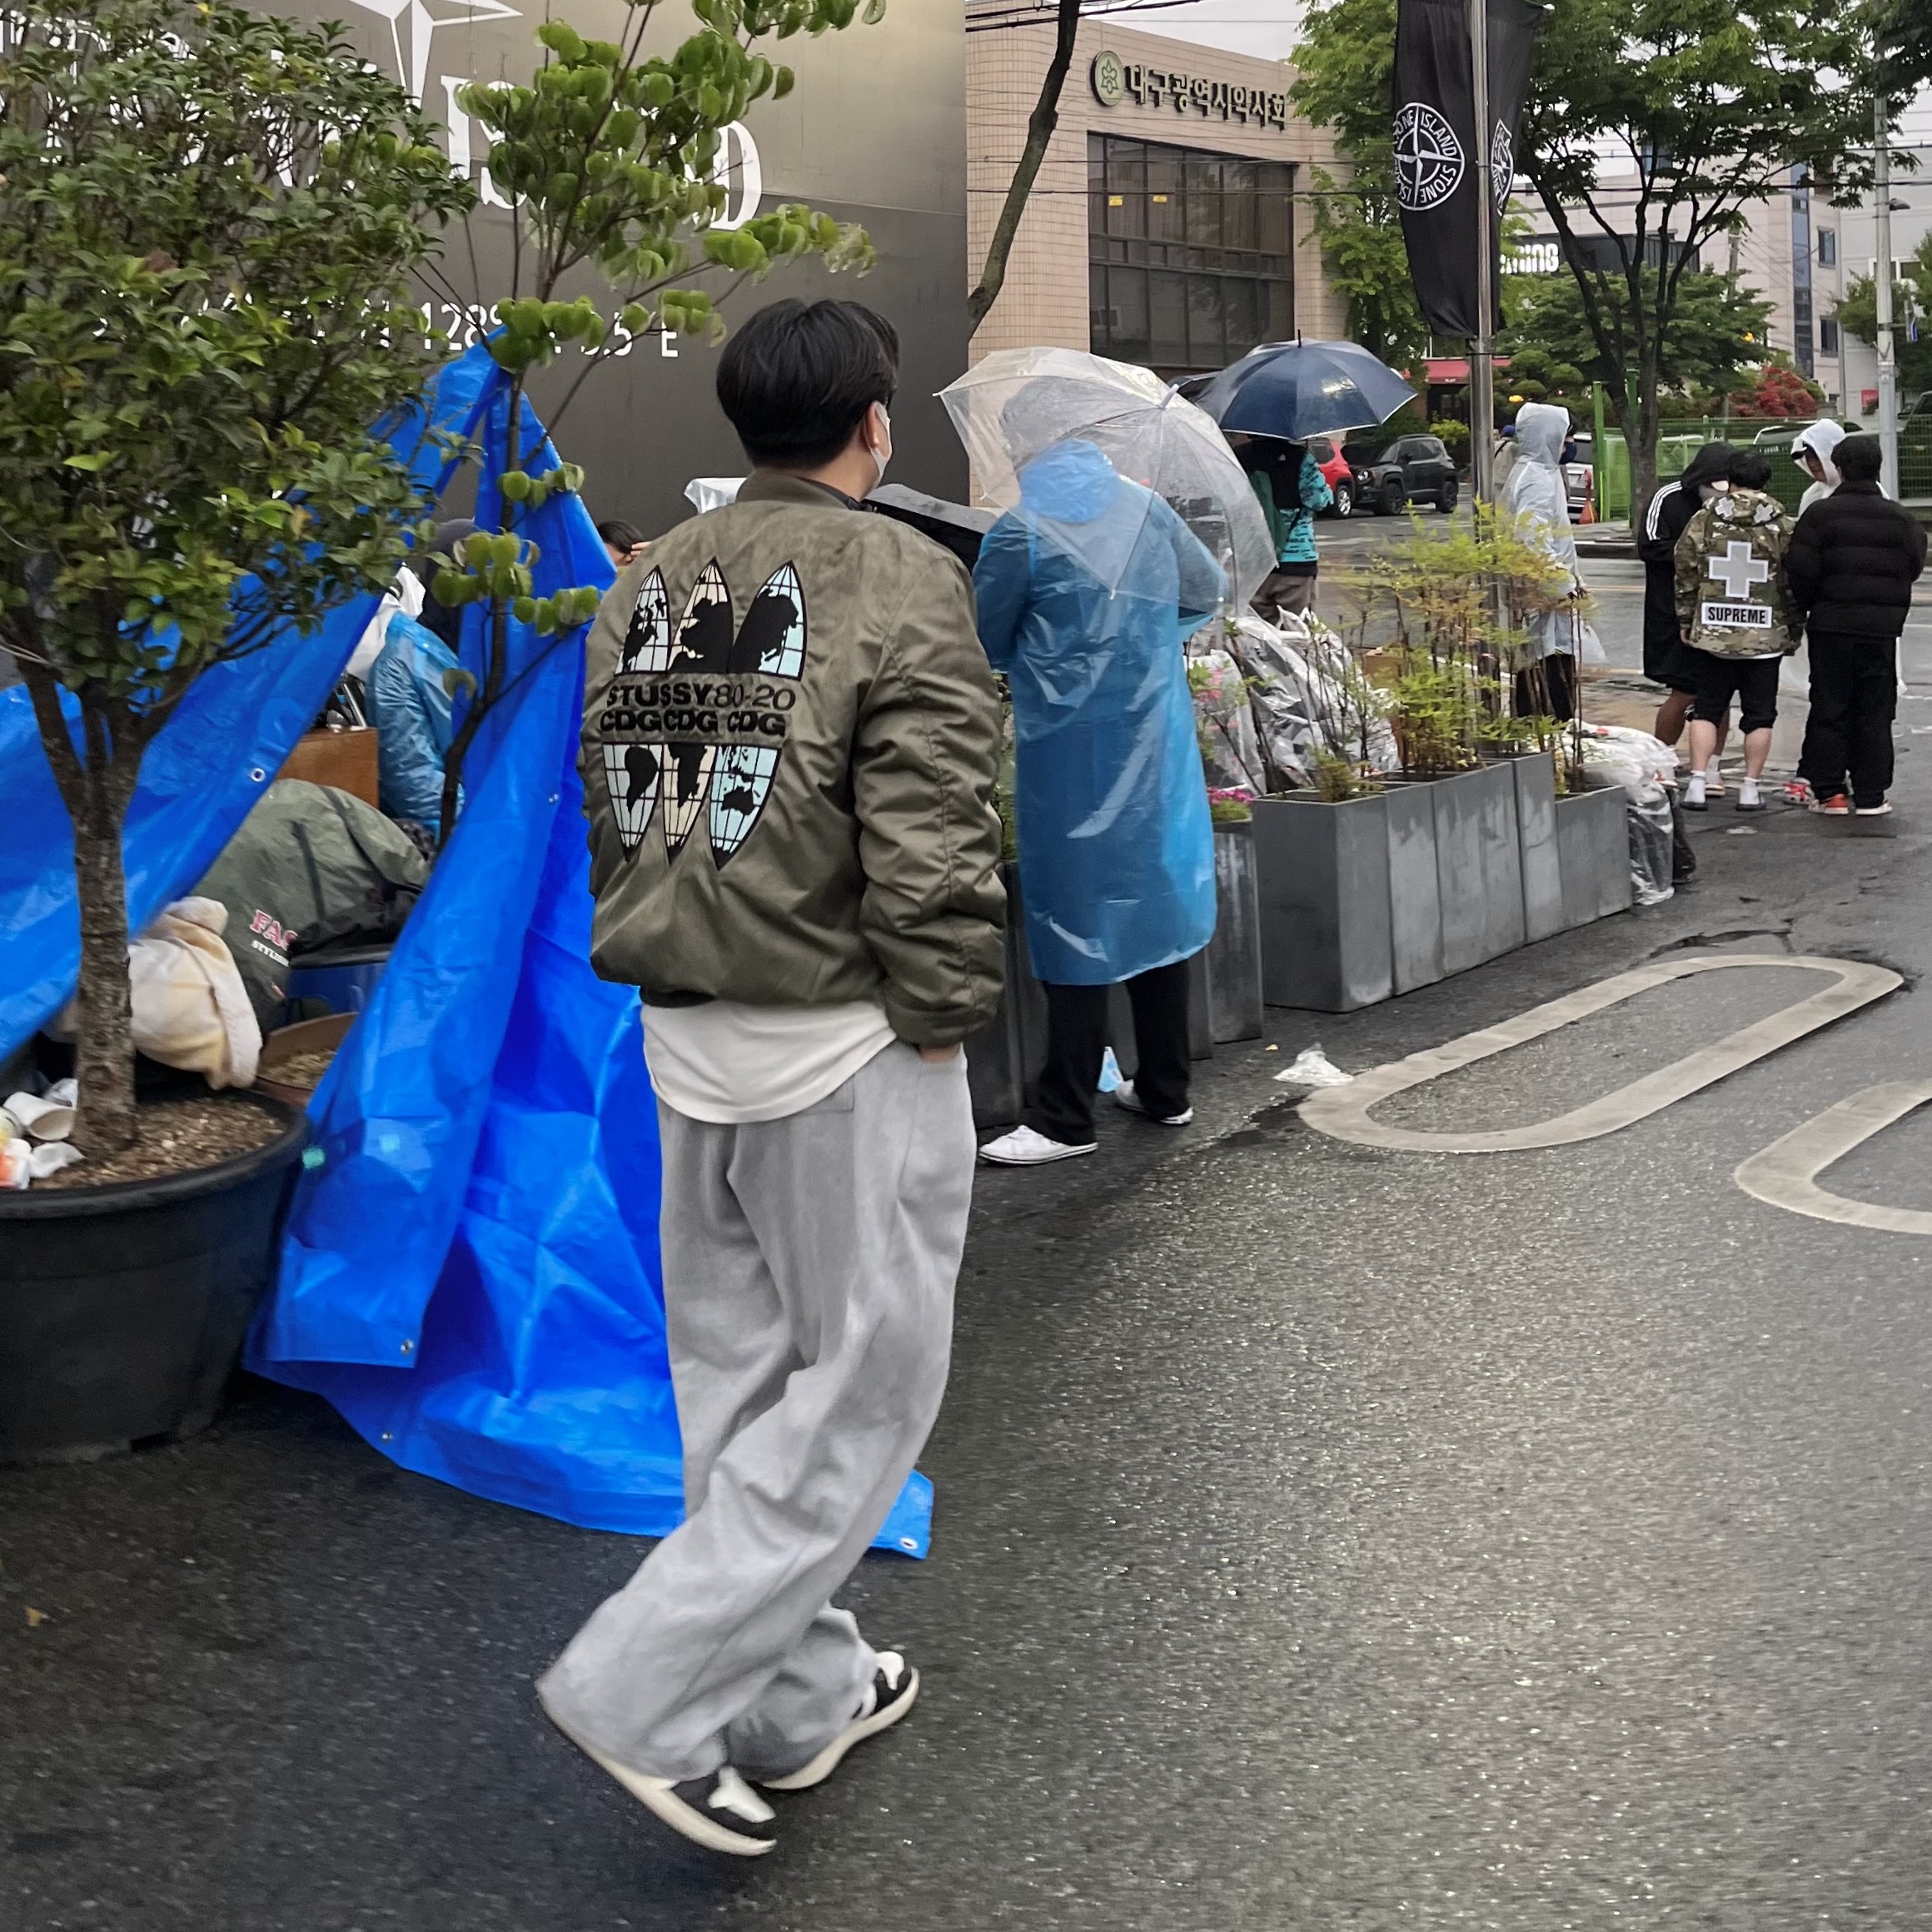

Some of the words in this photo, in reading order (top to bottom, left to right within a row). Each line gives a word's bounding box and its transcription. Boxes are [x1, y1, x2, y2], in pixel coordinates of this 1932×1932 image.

[1125, 64, 1287, 131] 대구광역시약사회
[1420, 111, 1458, 157] ISLAND
[1420, 164, 1457, 204] STONE
[1707, 606, 1766, 625] SUPREME
[606, 681, 712, 707] STUSSY
[713, 683, 796, 711] 80-20
[599, 710, 663, 733] CDG
[663, 710, 719, 733] CDG
[726, 710, 786, 737] CDG
